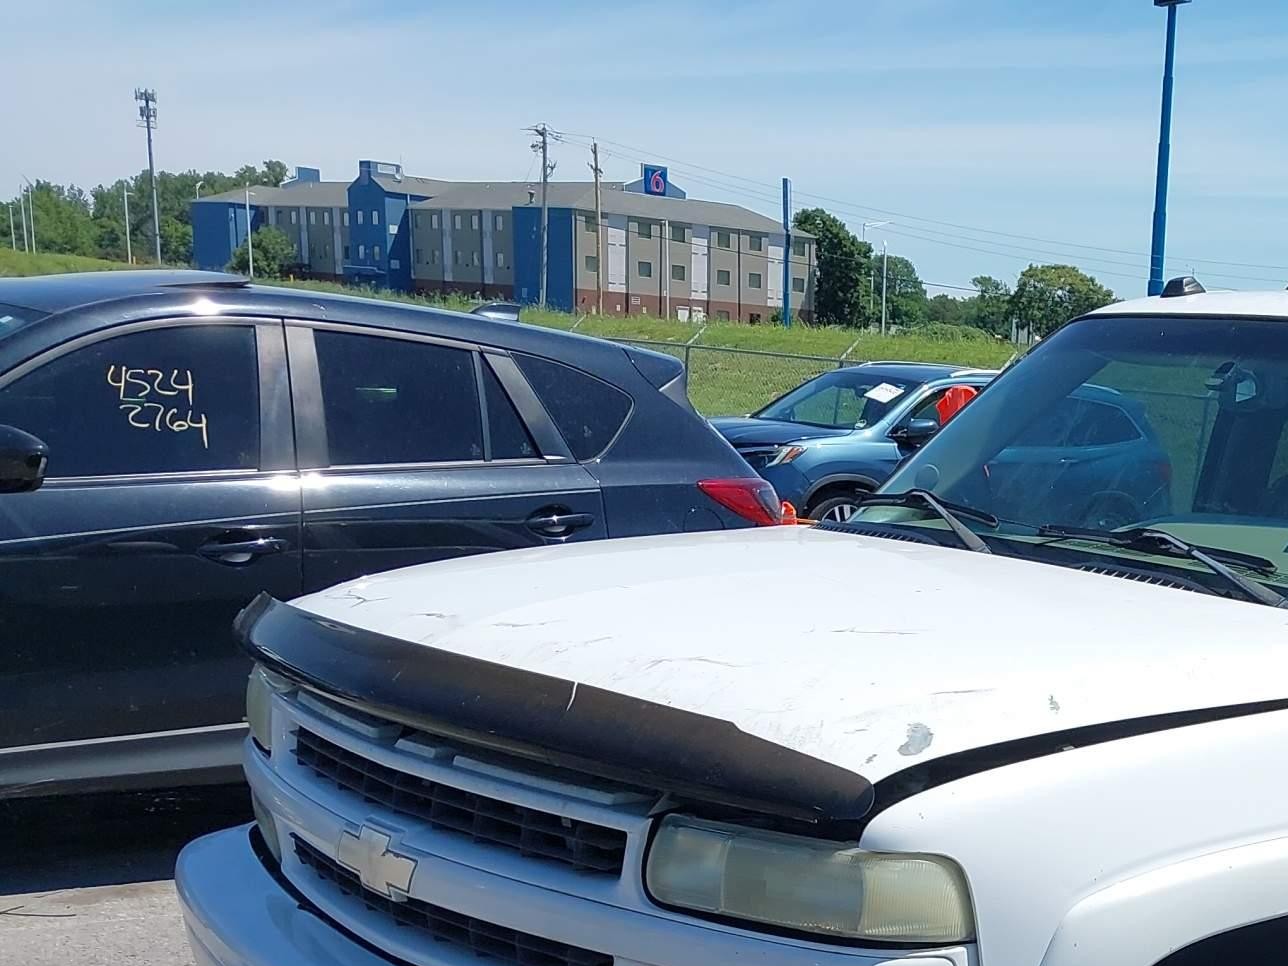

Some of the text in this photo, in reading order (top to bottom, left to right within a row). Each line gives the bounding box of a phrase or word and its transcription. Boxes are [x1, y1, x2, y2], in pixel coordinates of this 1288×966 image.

[651, 170, 665, 192] 6
[107, 365, 194, 405] 4524
[119, 403, 209, 448] 2764
